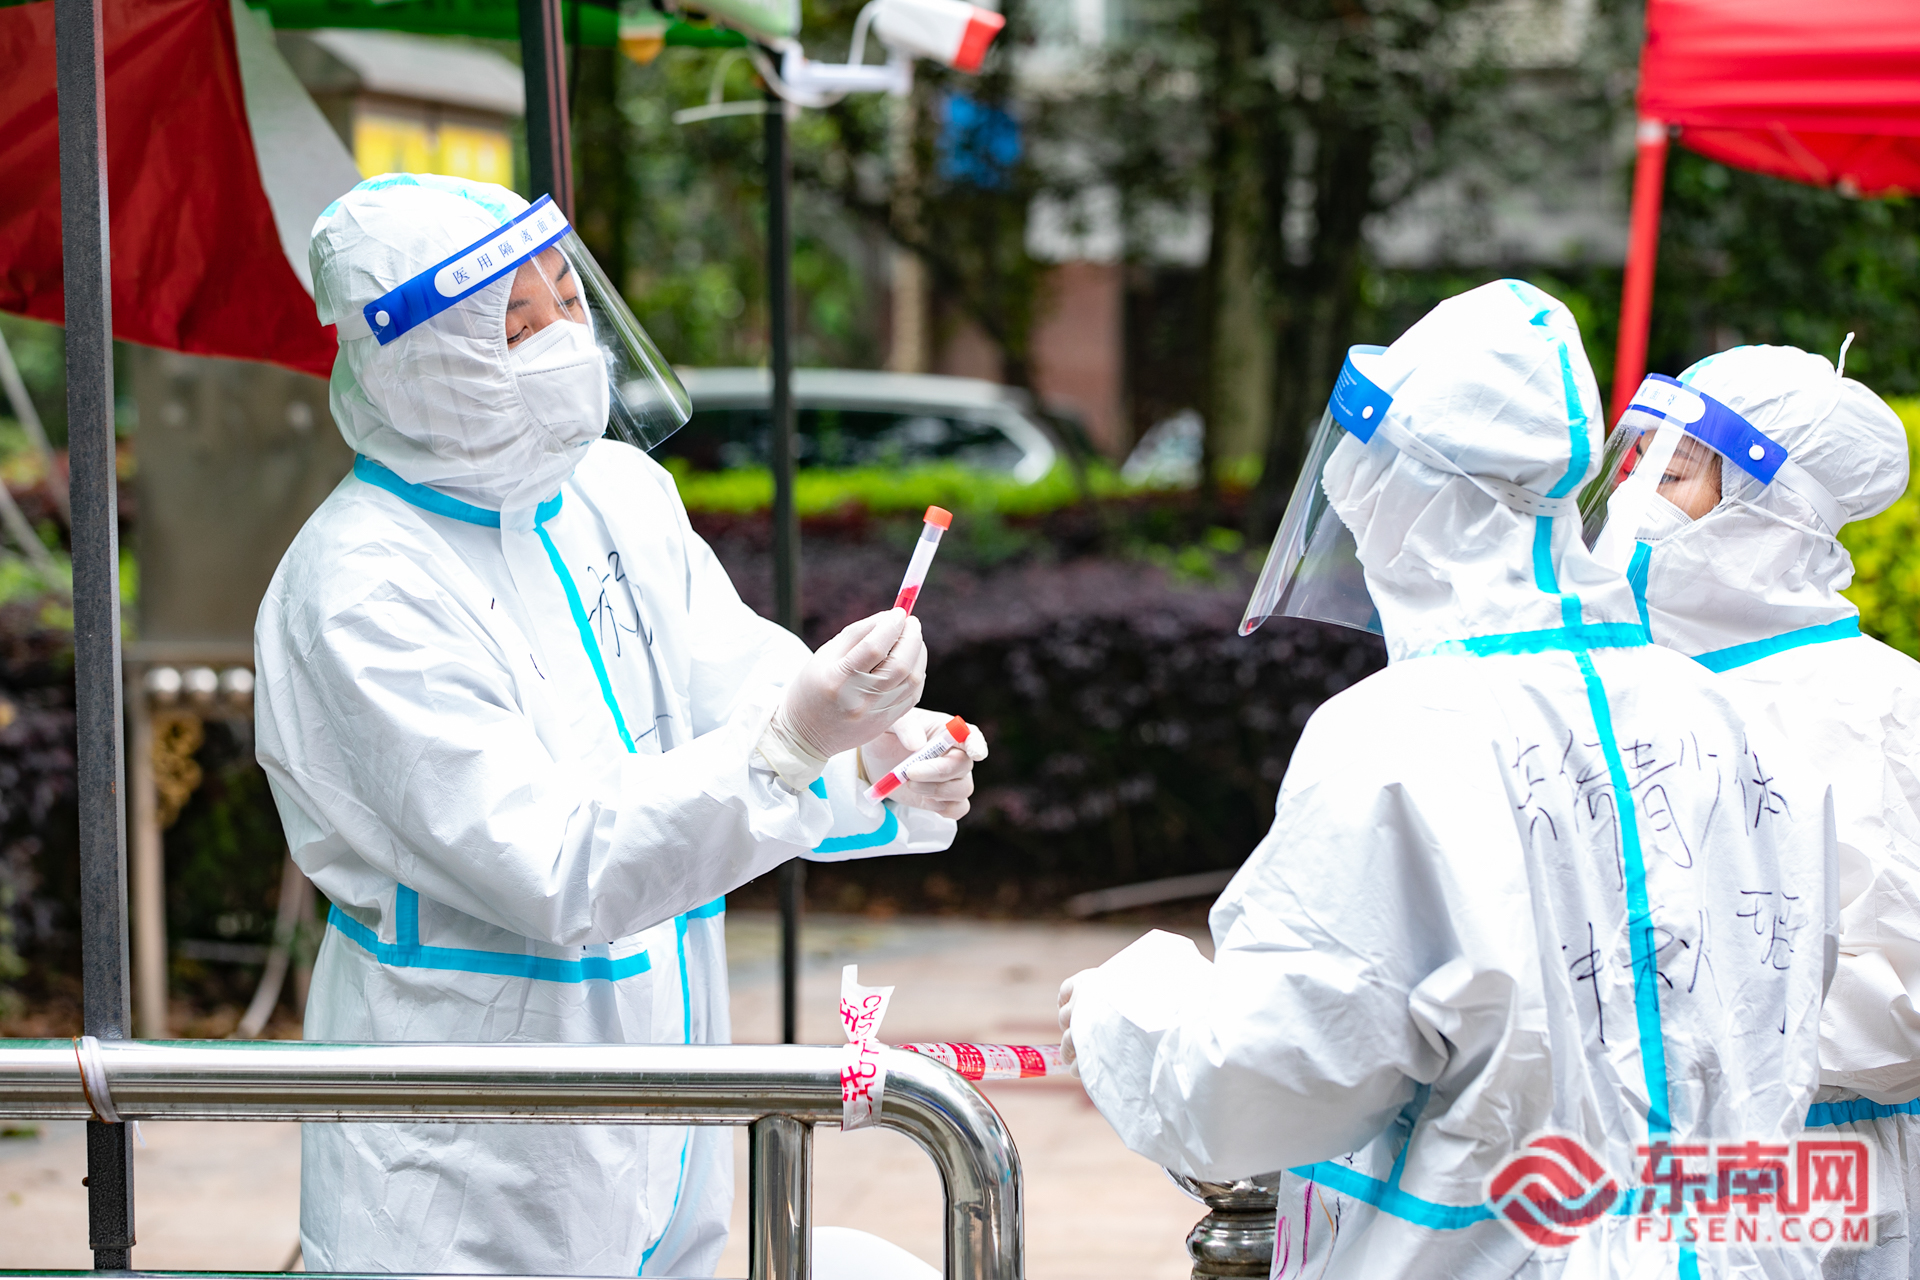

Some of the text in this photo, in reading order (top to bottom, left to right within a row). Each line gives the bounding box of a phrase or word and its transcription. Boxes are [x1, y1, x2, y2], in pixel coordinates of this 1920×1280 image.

[452, 210, 558, 285] 医用隔离面
[960, 1054, 982, 1073] SAFE
